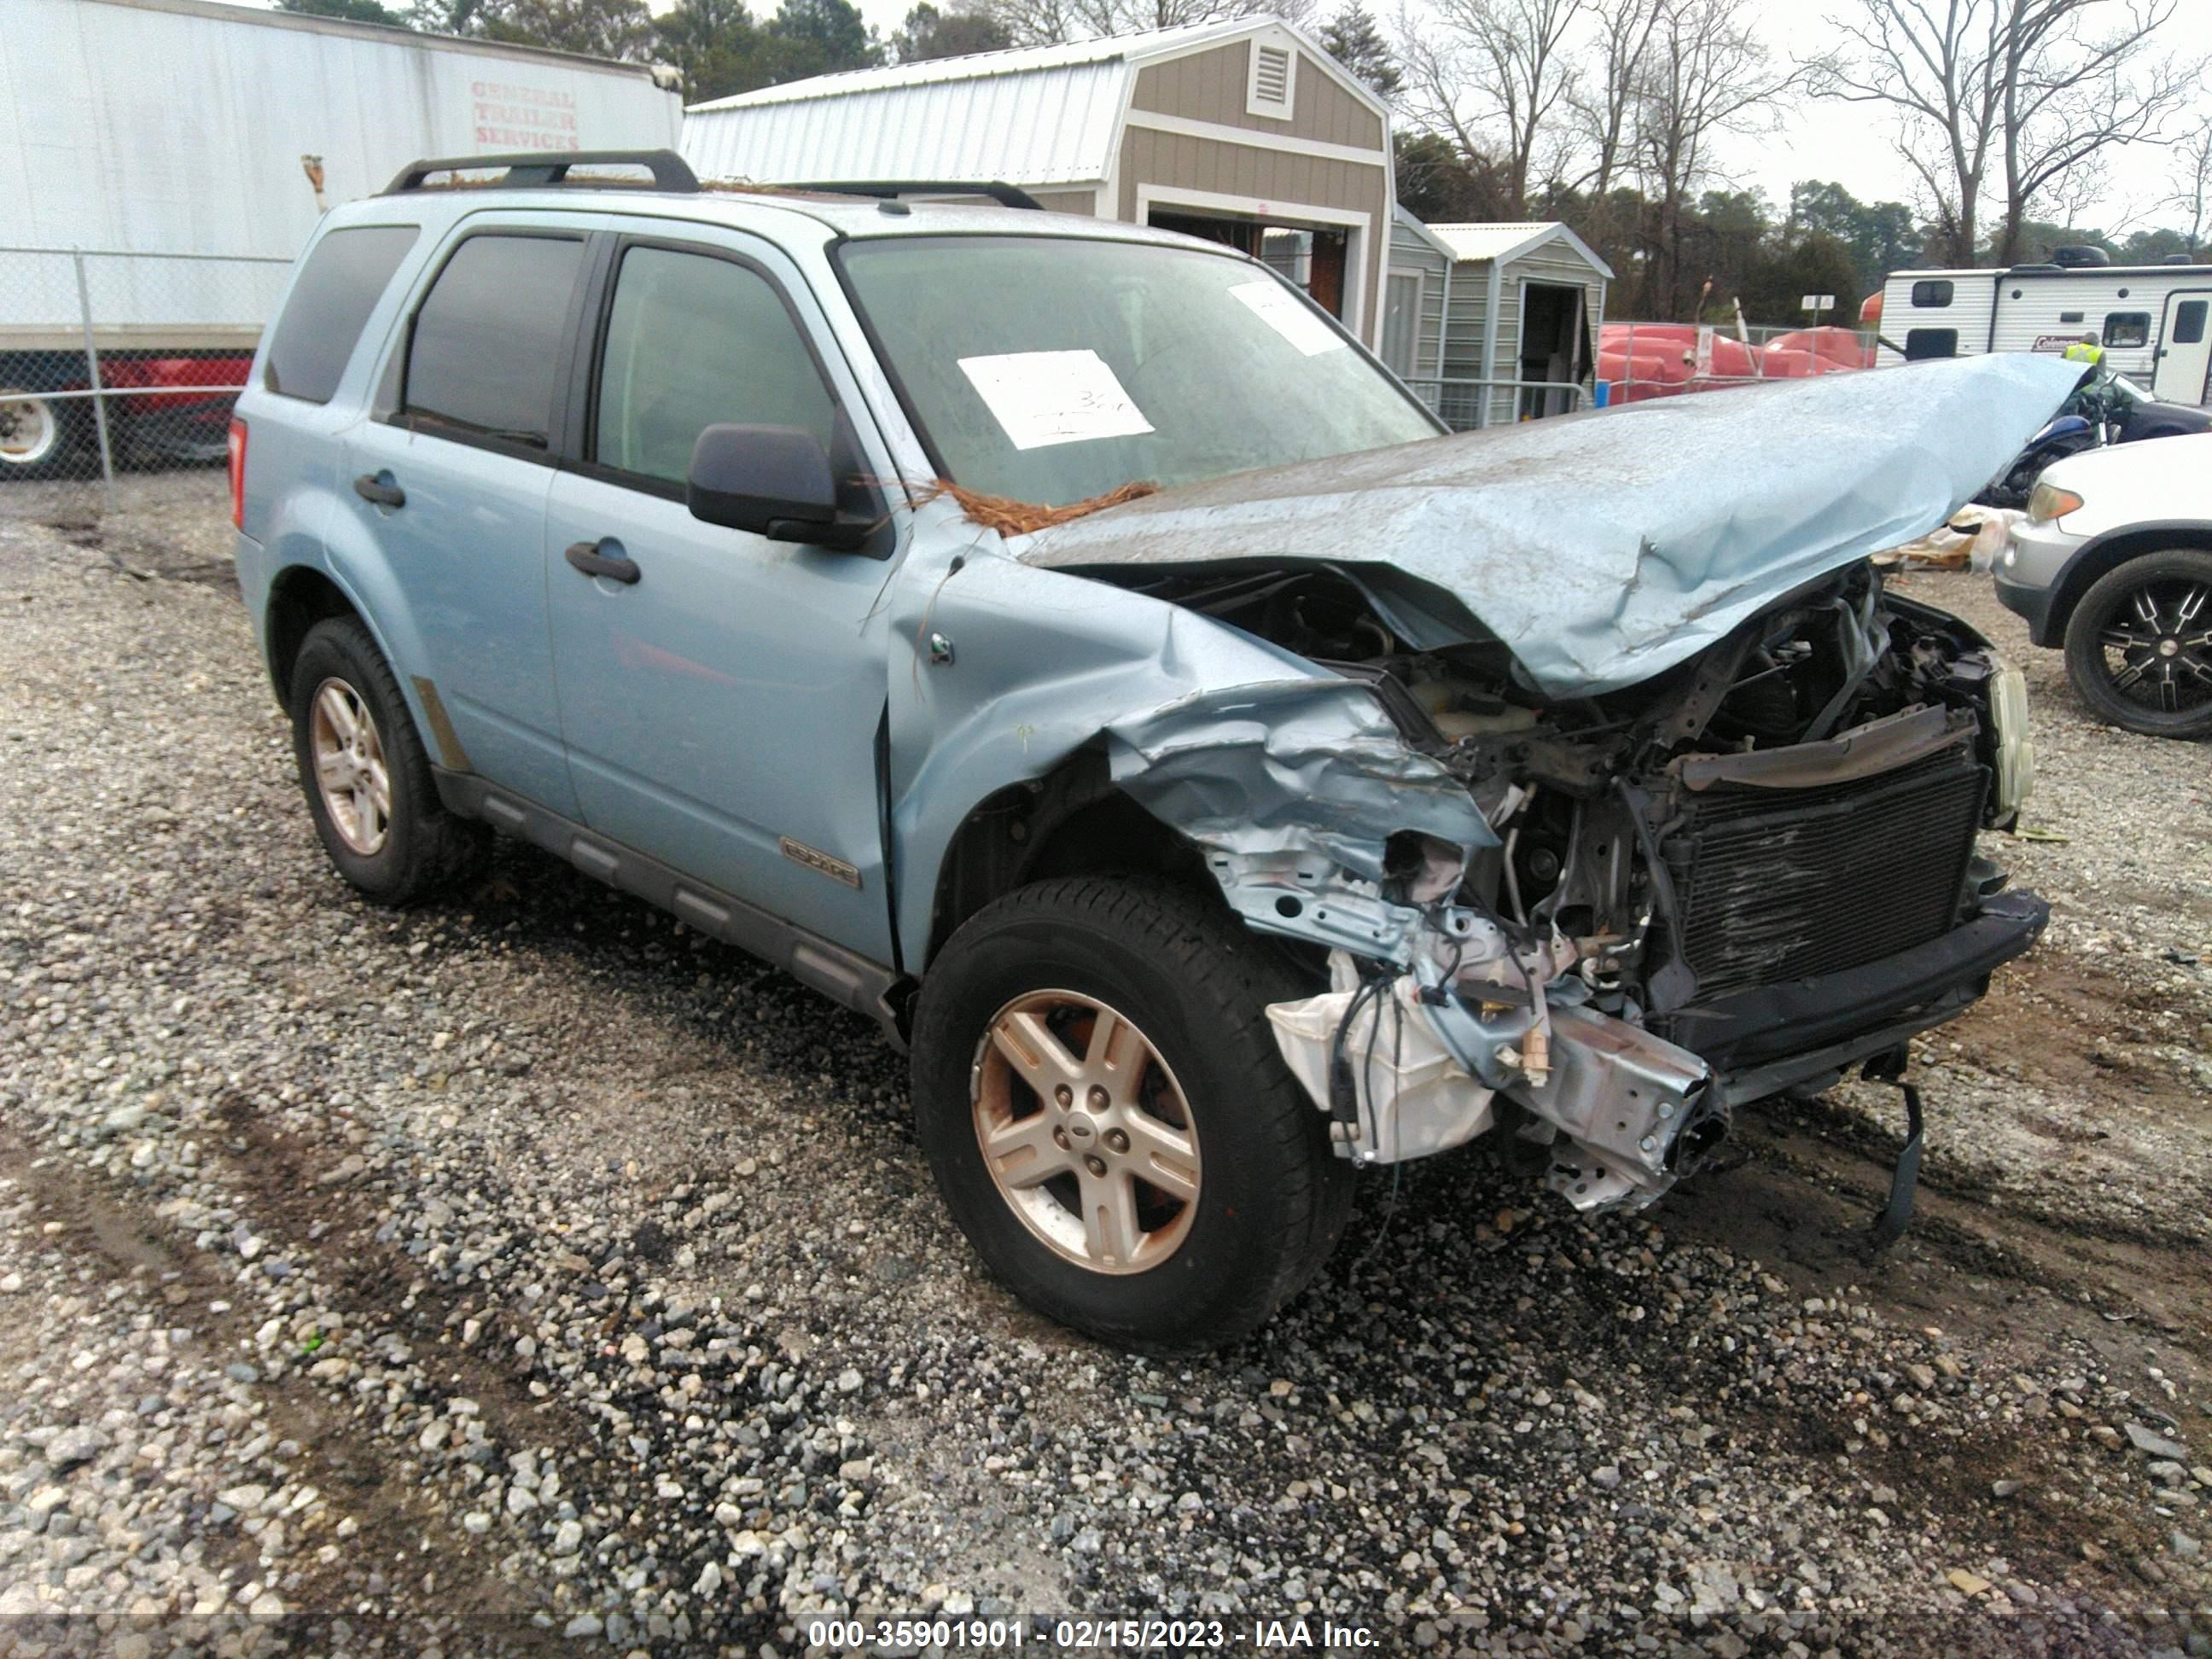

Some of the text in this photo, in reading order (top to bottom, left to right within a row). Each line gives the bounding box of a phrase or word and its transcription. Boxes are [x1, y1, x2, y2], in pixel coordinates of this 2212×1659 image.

[472, 82, 575, 108] GENERAL
[475, 102, 575, 130] TRAILER
[476, 126, 580, 150] SERVICES
